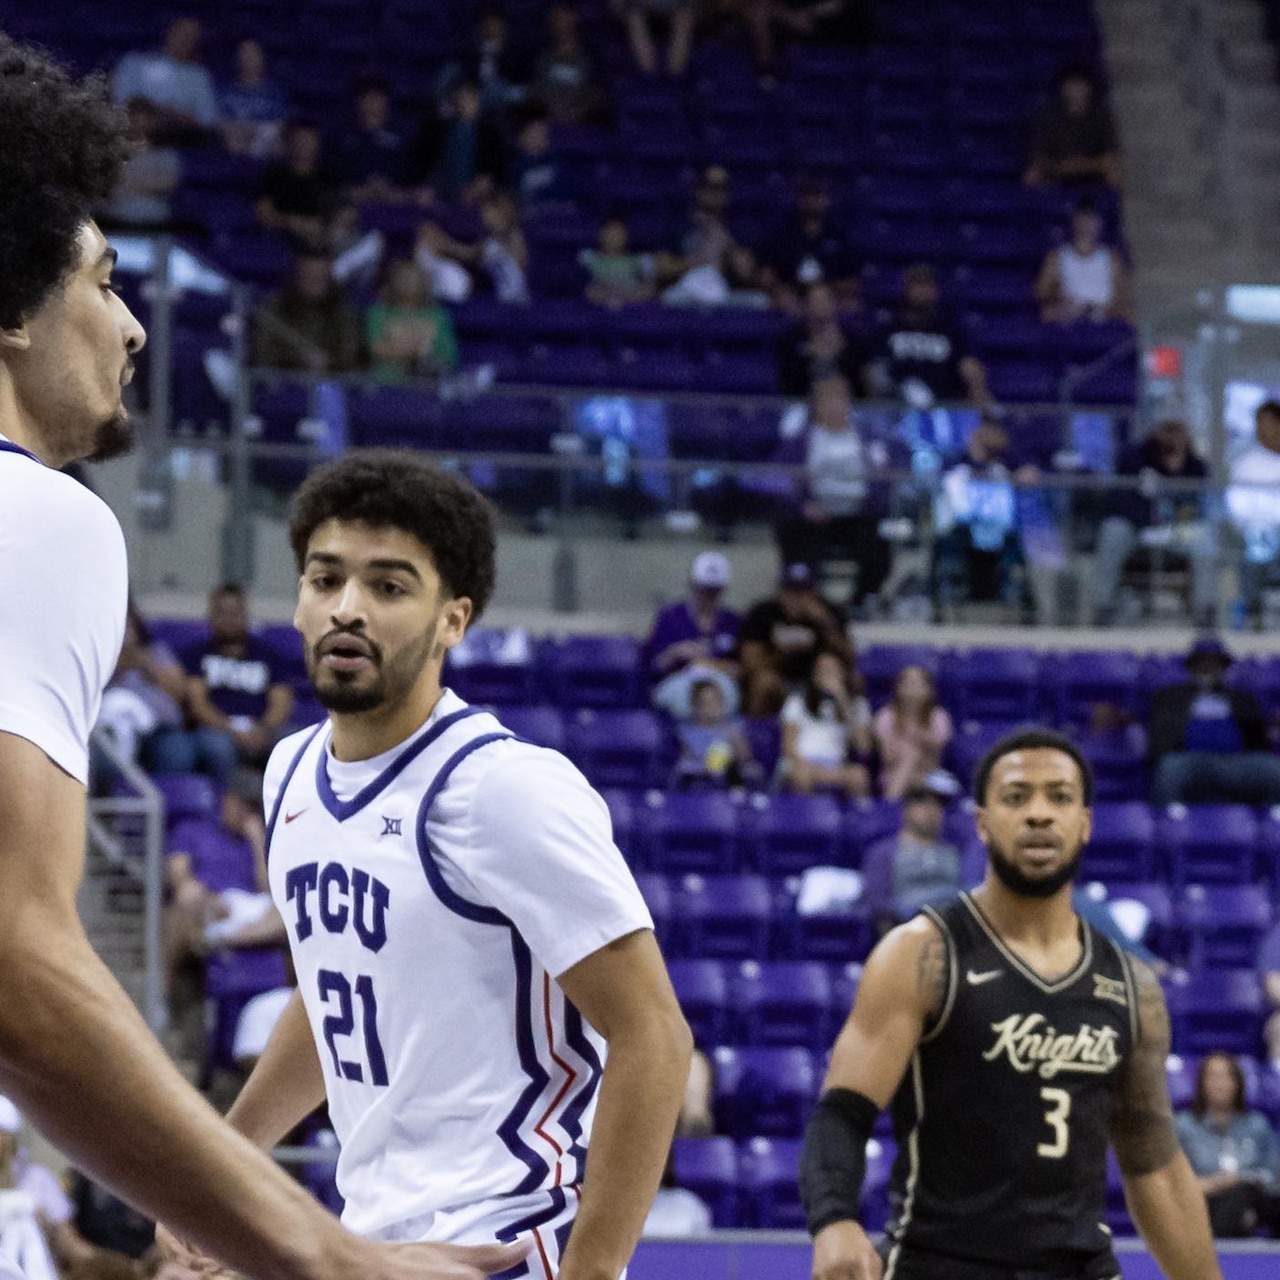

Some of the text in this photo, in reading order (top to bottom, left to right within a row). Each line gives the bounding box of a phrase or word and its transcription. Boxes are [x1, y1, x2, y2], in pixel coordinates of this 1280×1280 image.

[286, 861, 390, 954] TCU
[317, 967, 389, 1087] 21
[982, 1012, 1123, 1079] Knights
[1036, 1086, 1071, 1159] 3
